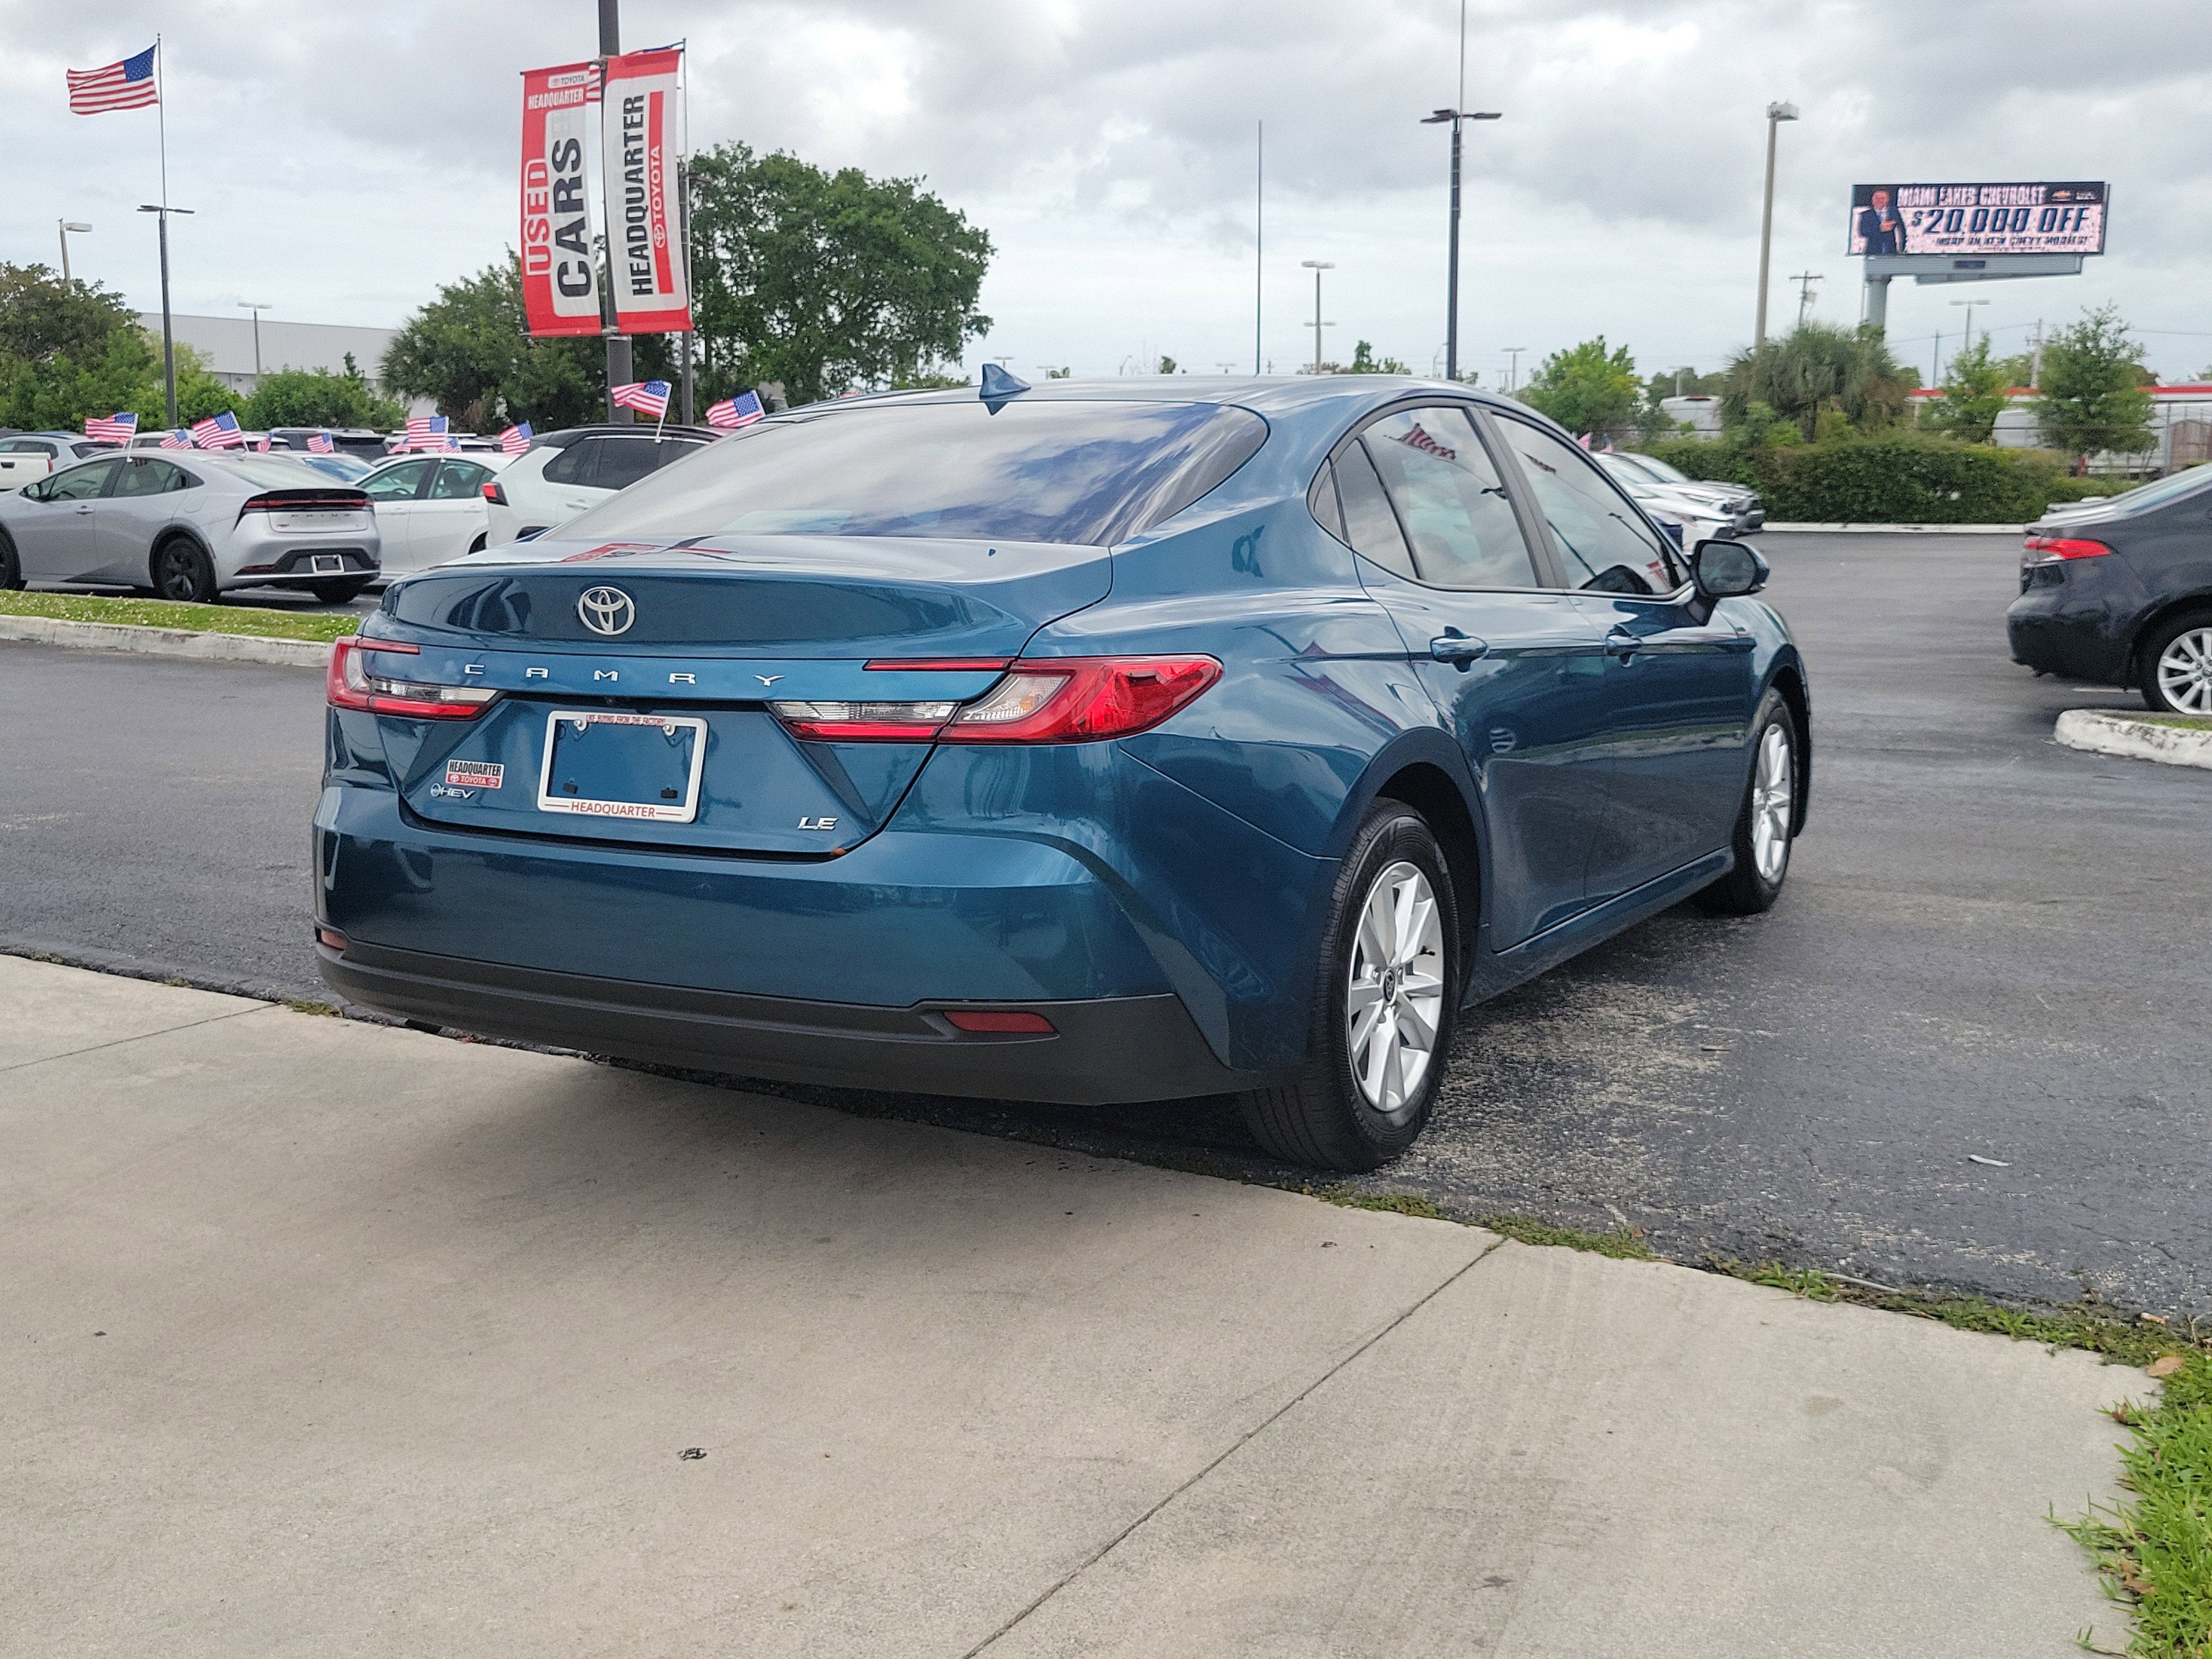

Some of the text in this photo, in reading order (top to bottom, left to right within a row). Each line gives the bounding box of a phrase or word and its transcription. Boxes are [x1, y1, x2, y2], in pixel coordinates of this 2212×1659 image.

[561, 75, 585, 85] TOYOTA
[528, 88, 584, 110] HEADQUARTER
[650, 145, 664, 223] TOYOTA
[624, 95, 653, 296] HEADQUARTER
[1979, 185, 2047, 206] CHEVROLET
[525, 159, 552, 275] USED
[551, 138, 592, 298] CARS
[2038, 207, 2089, 233] OFF
[464, 664, 785, 687] CAMRY
[449, 761, 502, 777] HEADQUARTER
[460, 775, 487, 785] TOYOTA
[441, 786, 476, 798] HEV
[571, 802, 656, 817] HEADQUARTER
[798, 816, 839, 831] LE
